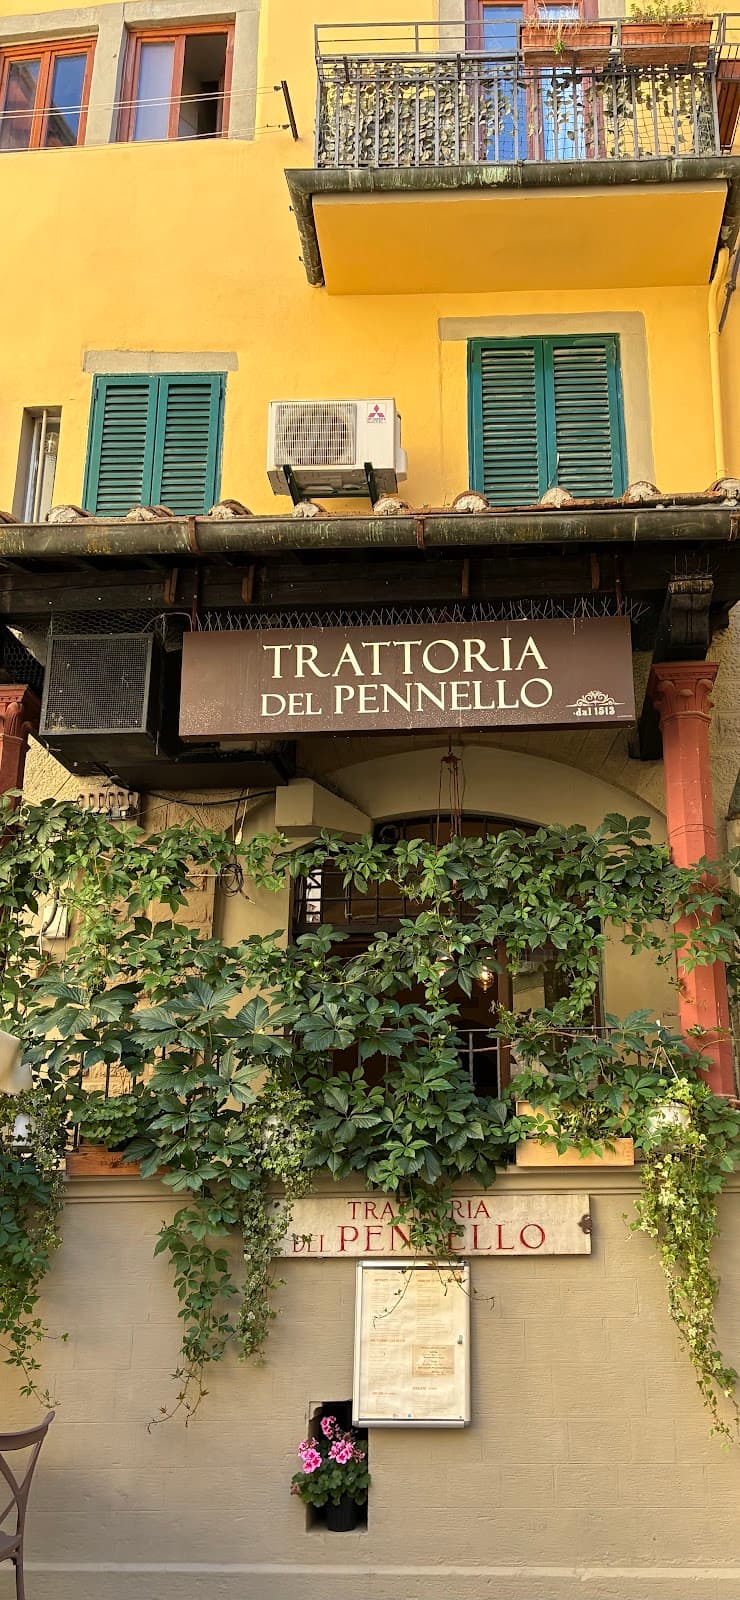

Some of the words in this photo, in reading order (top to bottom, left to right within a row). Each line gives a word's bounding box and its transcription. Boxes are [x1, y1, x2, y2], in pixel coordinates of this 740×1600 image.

[263, 636, 548, 679] TRATTORIA
[260, 692, 323, 717] DEL
[333, 678, 553, 714] PENNELLO
[594, 706, 616, 716] 1513
[347, 1200, 492, 1220] TRARIA
[292, 1234, 332, 1253] DEL
[336, 1223, 546, 1252] PENELLO
